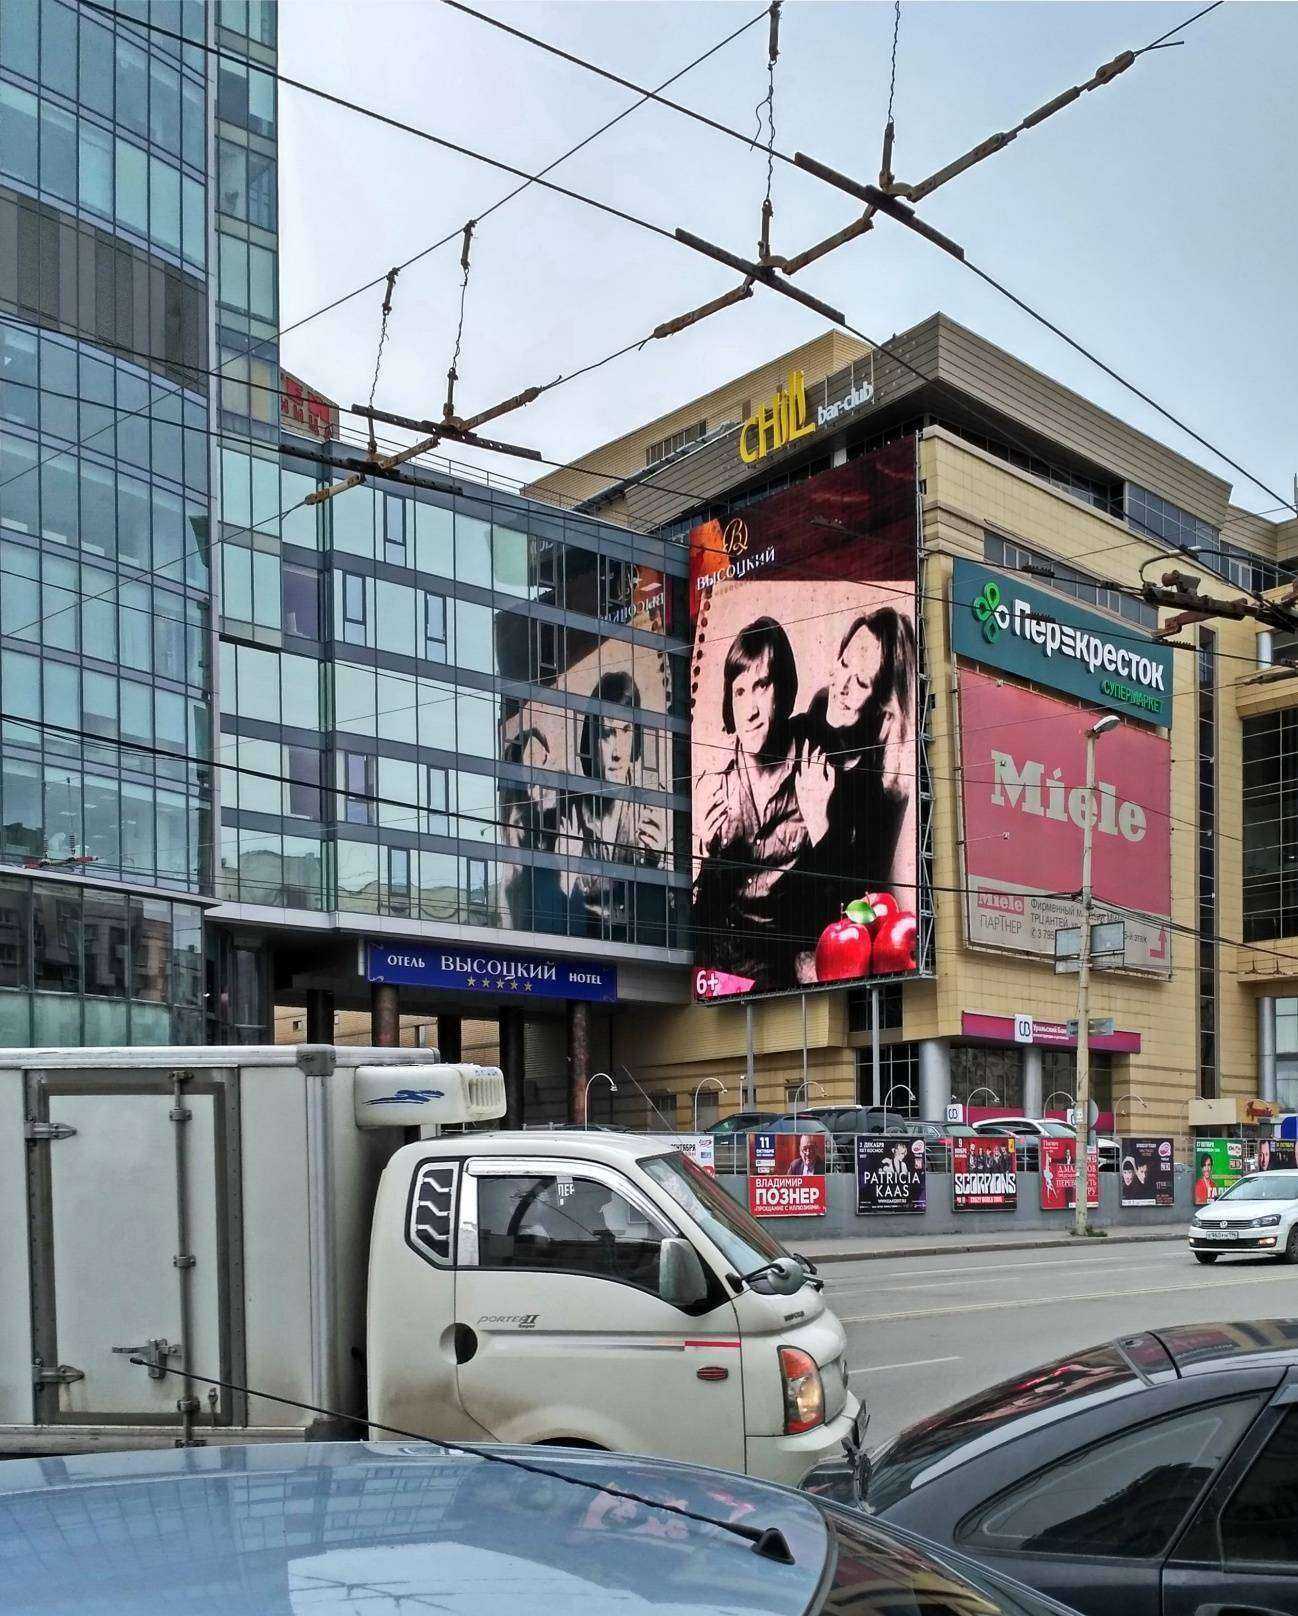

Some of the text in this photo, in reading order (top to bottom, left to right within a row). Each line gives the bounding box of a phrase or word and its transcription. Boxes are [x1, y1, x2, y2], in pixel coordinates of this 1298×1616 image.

[817, 381, 874, 426] bar-club
[697, 545, 775, 590] ВЫСОЦКИЙ
[1013, 598, 1165, 692] Перекресток
[1103, 680, 1165, 713] СУПЕРМАРКЕТ
[991, 749, 1147, 842] Miele
[1030, 898, 1076, 917] Фирменный
[979, 914, 1023, 935] ПАРТНЕР
[387, 954, 602, 985] ОТЕЛЬ ВЫСОЦКИЙ HOTEL
[696, 970, 719, 995] 6+
[759, 1136, 770, 1149] 11
[958, 1138, 963, 1148] 9
[755, 1178, 803, 1188] ВЛАДИМИР
[864, 1171, 921, 1184] PATRICIA
[954, 1171, 1016, 1195] SCORPIONS
[755, 1188, 820, 1205] ПОЗНЕР
[875, 1184, 909, 1197] KAAS
[477, 1315, 527, 1324] PORTER
